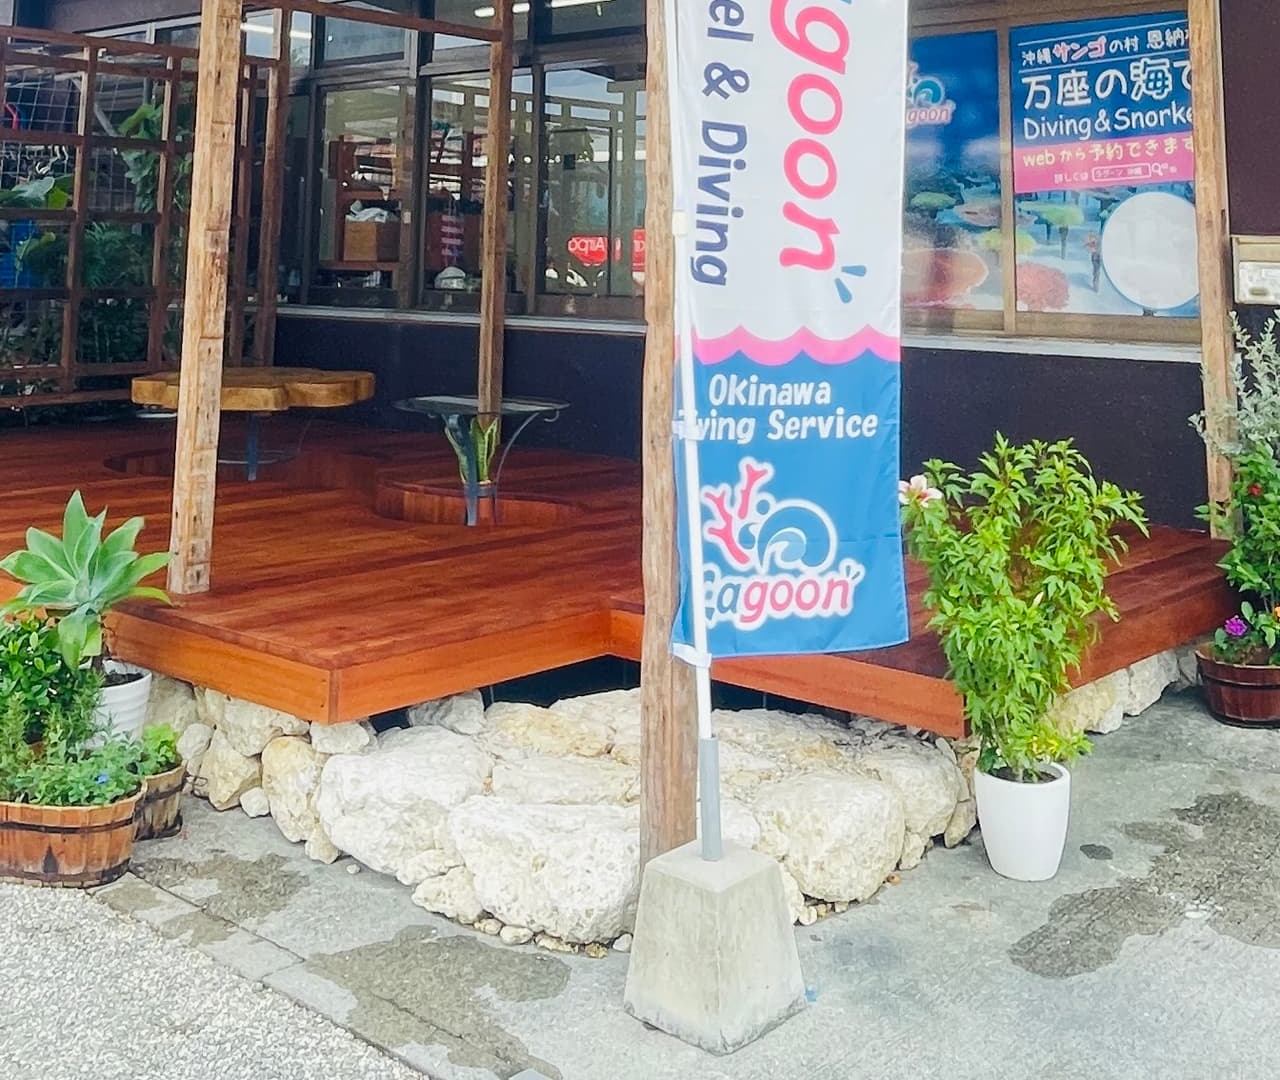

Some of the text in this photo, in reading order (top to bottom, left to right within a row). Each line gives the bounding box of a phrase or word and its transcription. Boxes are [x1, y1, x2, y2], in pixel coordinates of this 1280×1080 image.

[1146, 27, 1191, 51] 恩納
[702, 61, 751, 100] &
[690, 119, 748, 288] Diving
[708, 373, 832, 407] Okinawa
[679, 407, 879, 445] ving Service
